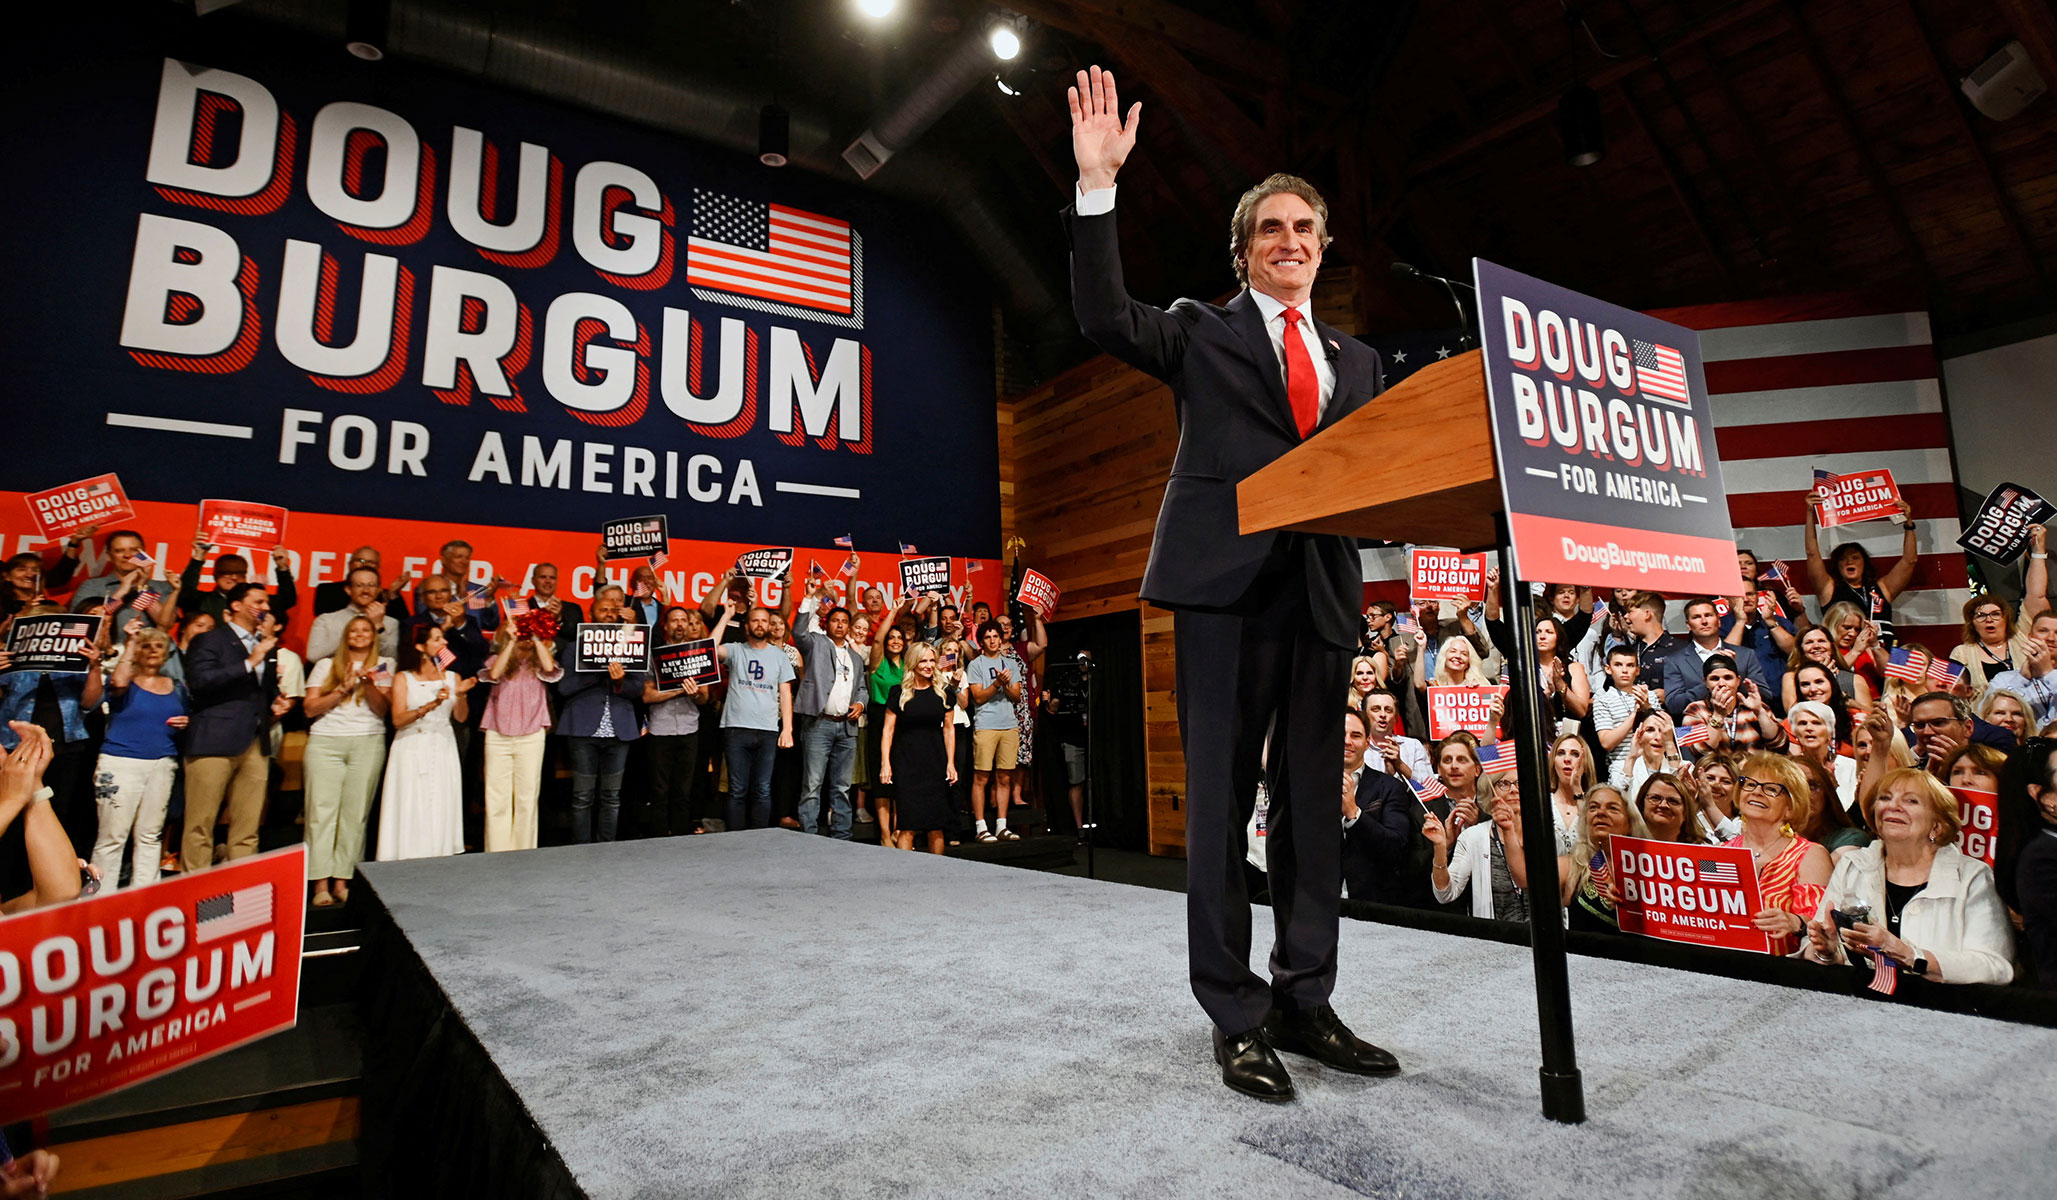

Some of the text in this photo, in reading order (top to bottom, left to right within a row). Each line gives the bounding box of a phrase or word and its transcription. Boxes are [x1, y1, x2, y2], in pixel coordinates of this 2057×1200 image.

[146, 57, 667, 277] DOUG
[118, 212, 864, 442] BURGUM
[1501, 295, 1633, 390] DOUG
[1511, 371, 1703, 474] BURGUM
[279, 408, 763, 508] FOR AMERICA
[1560, 463, 1683, 509] FOR AMERICA
[36, 487, 88, 513] DOUG
[42, 493, 120, 525] BURGUM
[1822, 487, 1893, 512] BURGUM
[1836, 509, 1851, 517] FOR
[1852, 503, 1884, 514] AMERICA
[61, 510, 112, 530] FOR AMERICA
[607, 522, 643, 536] DOUG
[1968, 505, 2004, 549] DOUG
[1983, 495, 2036, 556] BURGUM
[607, 532, 662, 548] BURGUM
[2008, 538, 2022, 551] FOR
[744, 559, 789, 569] URGUM
[1418, 555, 1461, 570] DOUG
[1561, 536, 1706, 575] DougBurgum.com
[904, 562, 936, 576] DOUG
[1418, 570, 1481, 586] BURGUM
[400, 556, 494, 593] FR
[571, 565, 784, 608] CHNGG
[1028, 574, 1052, 593] DOUG
[1442, 586, 1470, 594] AMERICA
[1025, 583, 1055, 609] BURGUM
[16, 621, 62, 640] DOUG
[583, 629, 625, 642] DOUG
[12, 637, 86, 654] BURGUM
[583, 643, 645, 656] BURGUM
[607, 656, 634, 664] AMERICA
[1434, 692, 1480, 707] DOUG
[1435, 707, 1491, 722] BURGU
[1959, 802, 1993, 831] UG
[1620, 849, 1696, 883] DOUG
[1623, 877, 1748, 916] BURGUM
[1645, 909, 1727, 931] FOR AMERICA
[33, 1051, 92, 1088] FOR
[105, 1001, 227, 1065] AMERICA
